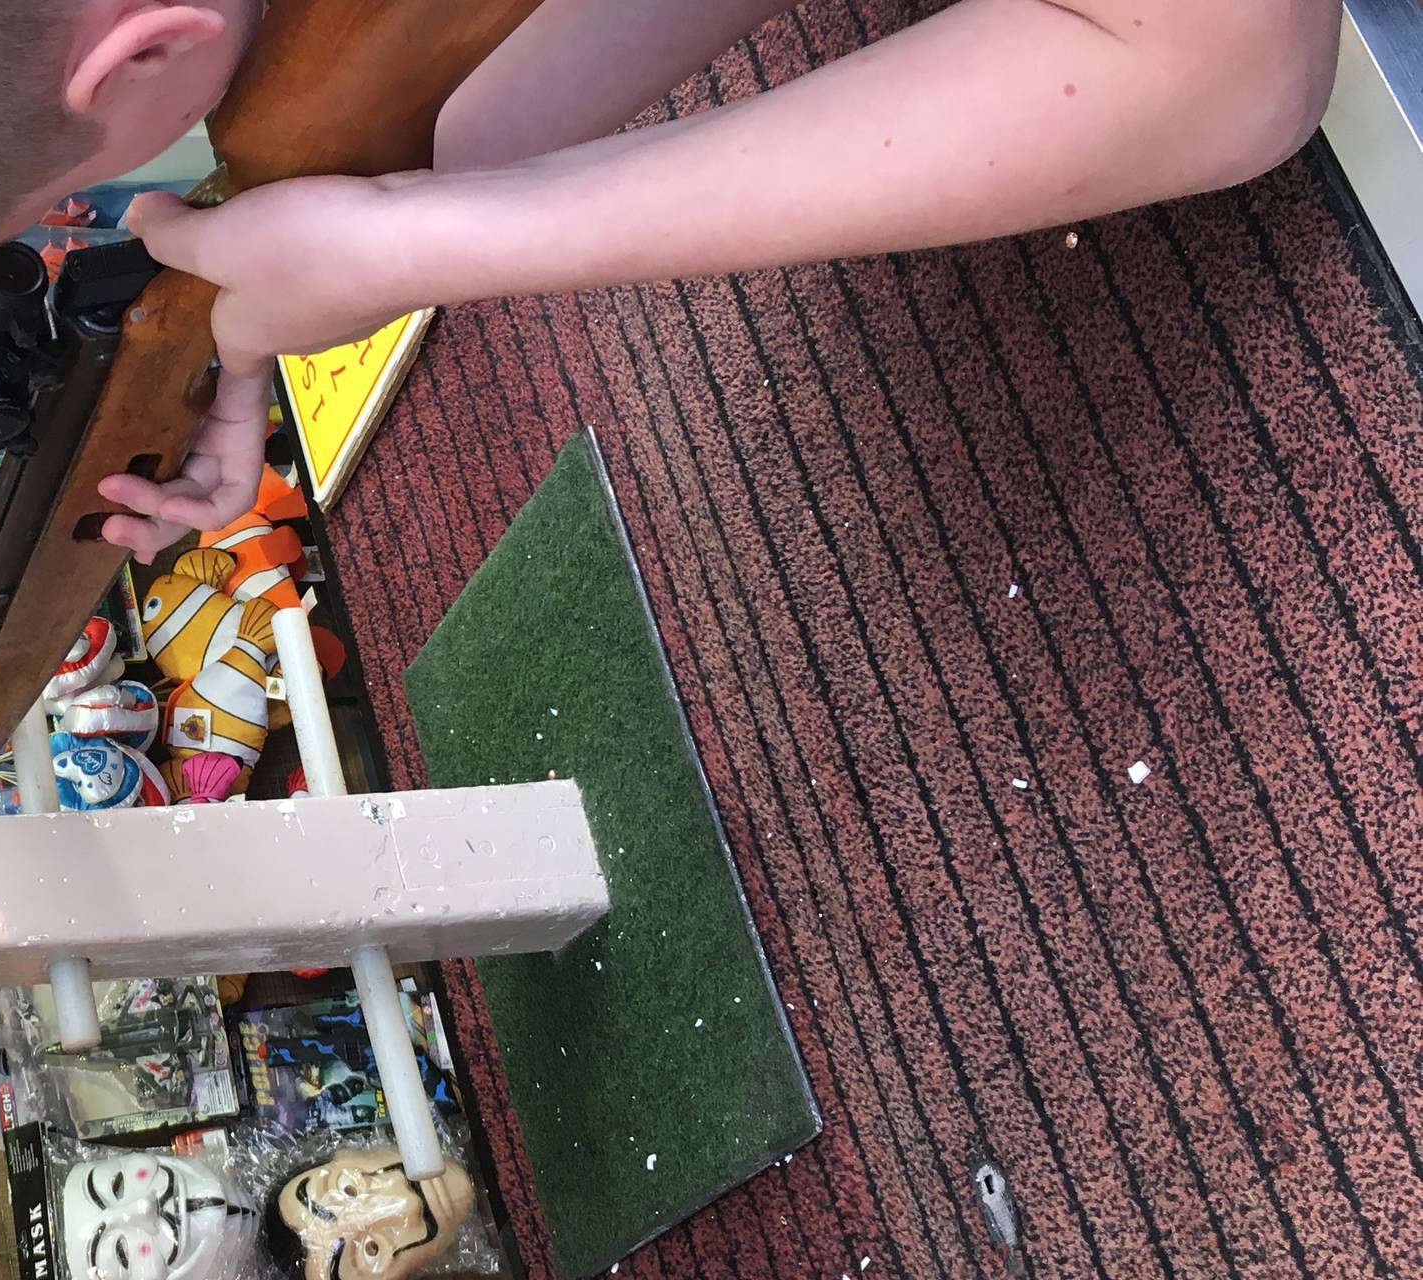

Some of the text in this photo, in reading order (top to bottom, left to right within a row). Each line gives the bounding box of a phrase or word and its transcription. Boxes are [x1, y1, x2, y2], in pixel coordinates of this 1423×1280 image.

[353, 337, 373, 366] 1
[330, 365, 346, 392] 7
[312, 394, 325, 422] 1
[238, 1021, 275, 1106] POLICE
[0, 1088, 15, 1131] LIGH
[29, 1202, 48, 1278] MASK
